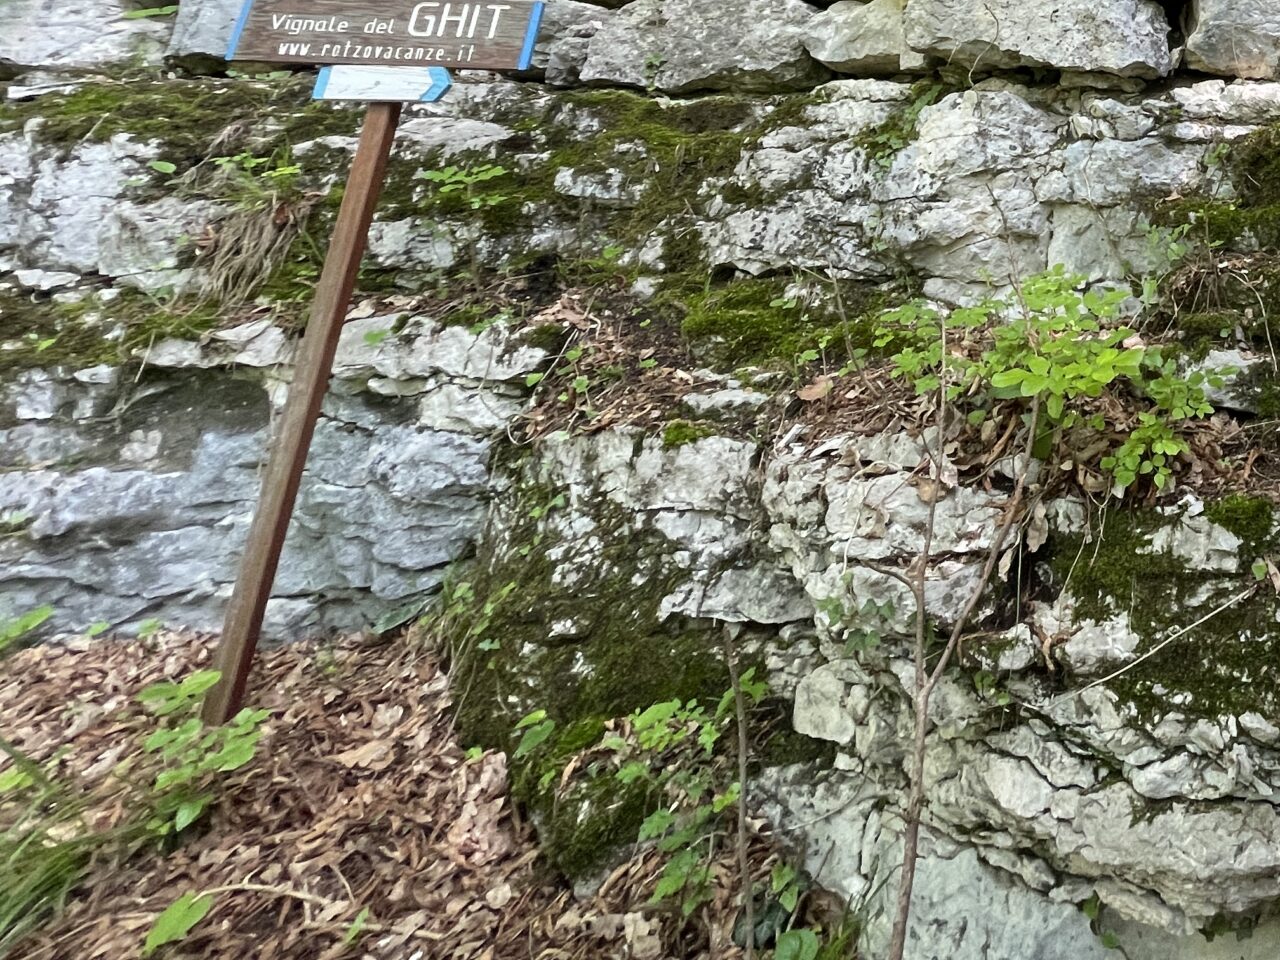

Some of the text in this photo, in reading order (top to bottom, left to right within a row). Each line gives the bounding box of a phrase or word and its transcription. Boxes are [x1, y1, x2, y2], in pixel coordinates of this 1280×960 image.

[272, 1, 511, 39] Vignale del GHIT
[278, 40, 475, 63] www.rotzovacanze.it
